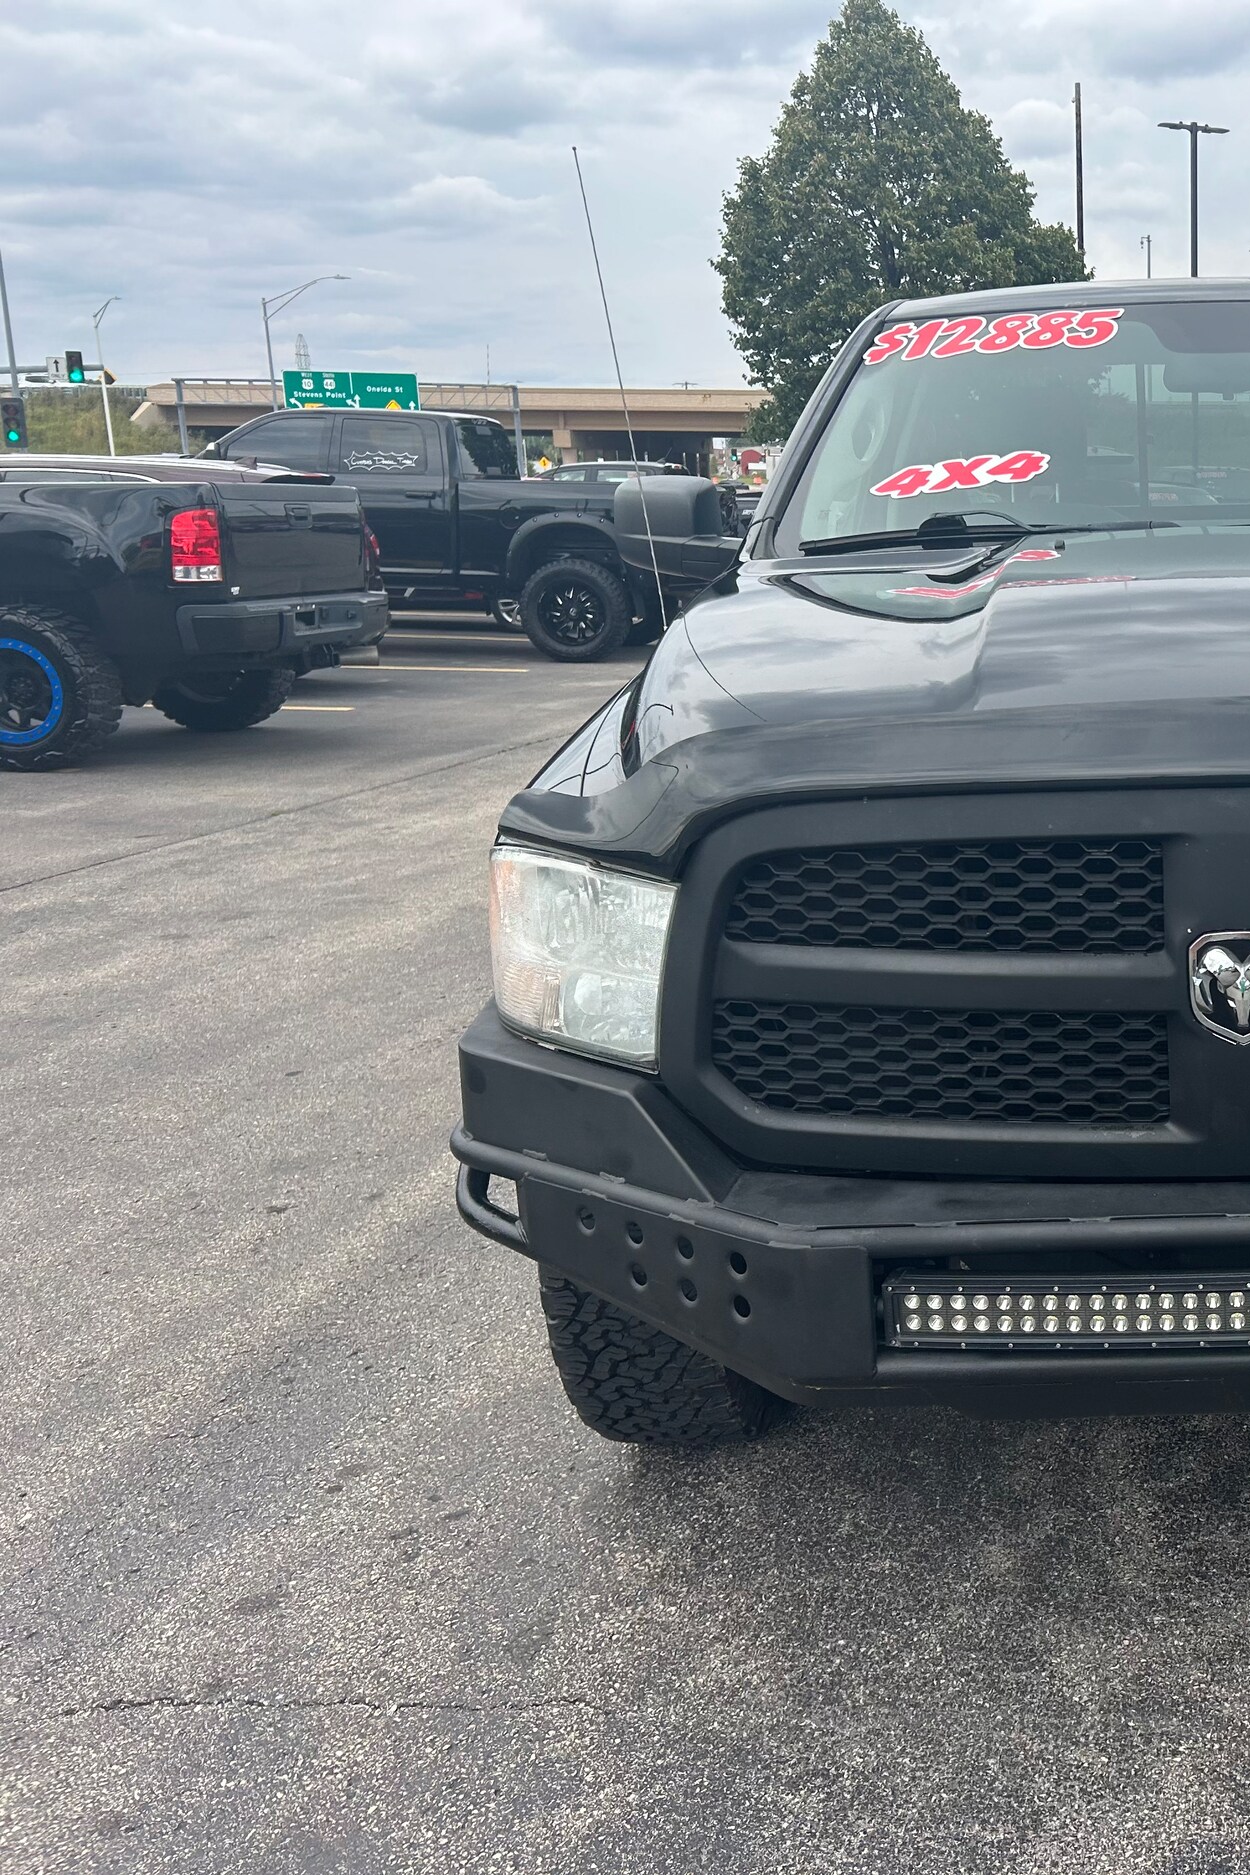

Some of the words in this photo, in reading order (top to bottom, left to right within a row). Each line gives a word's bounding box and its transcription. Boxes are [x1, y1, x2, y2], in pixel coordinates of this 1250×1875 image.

[863, 308, 1125, 365] $12885
[366, 385, 392, 393] Oneida
[325, 391, 346, 399] Point
